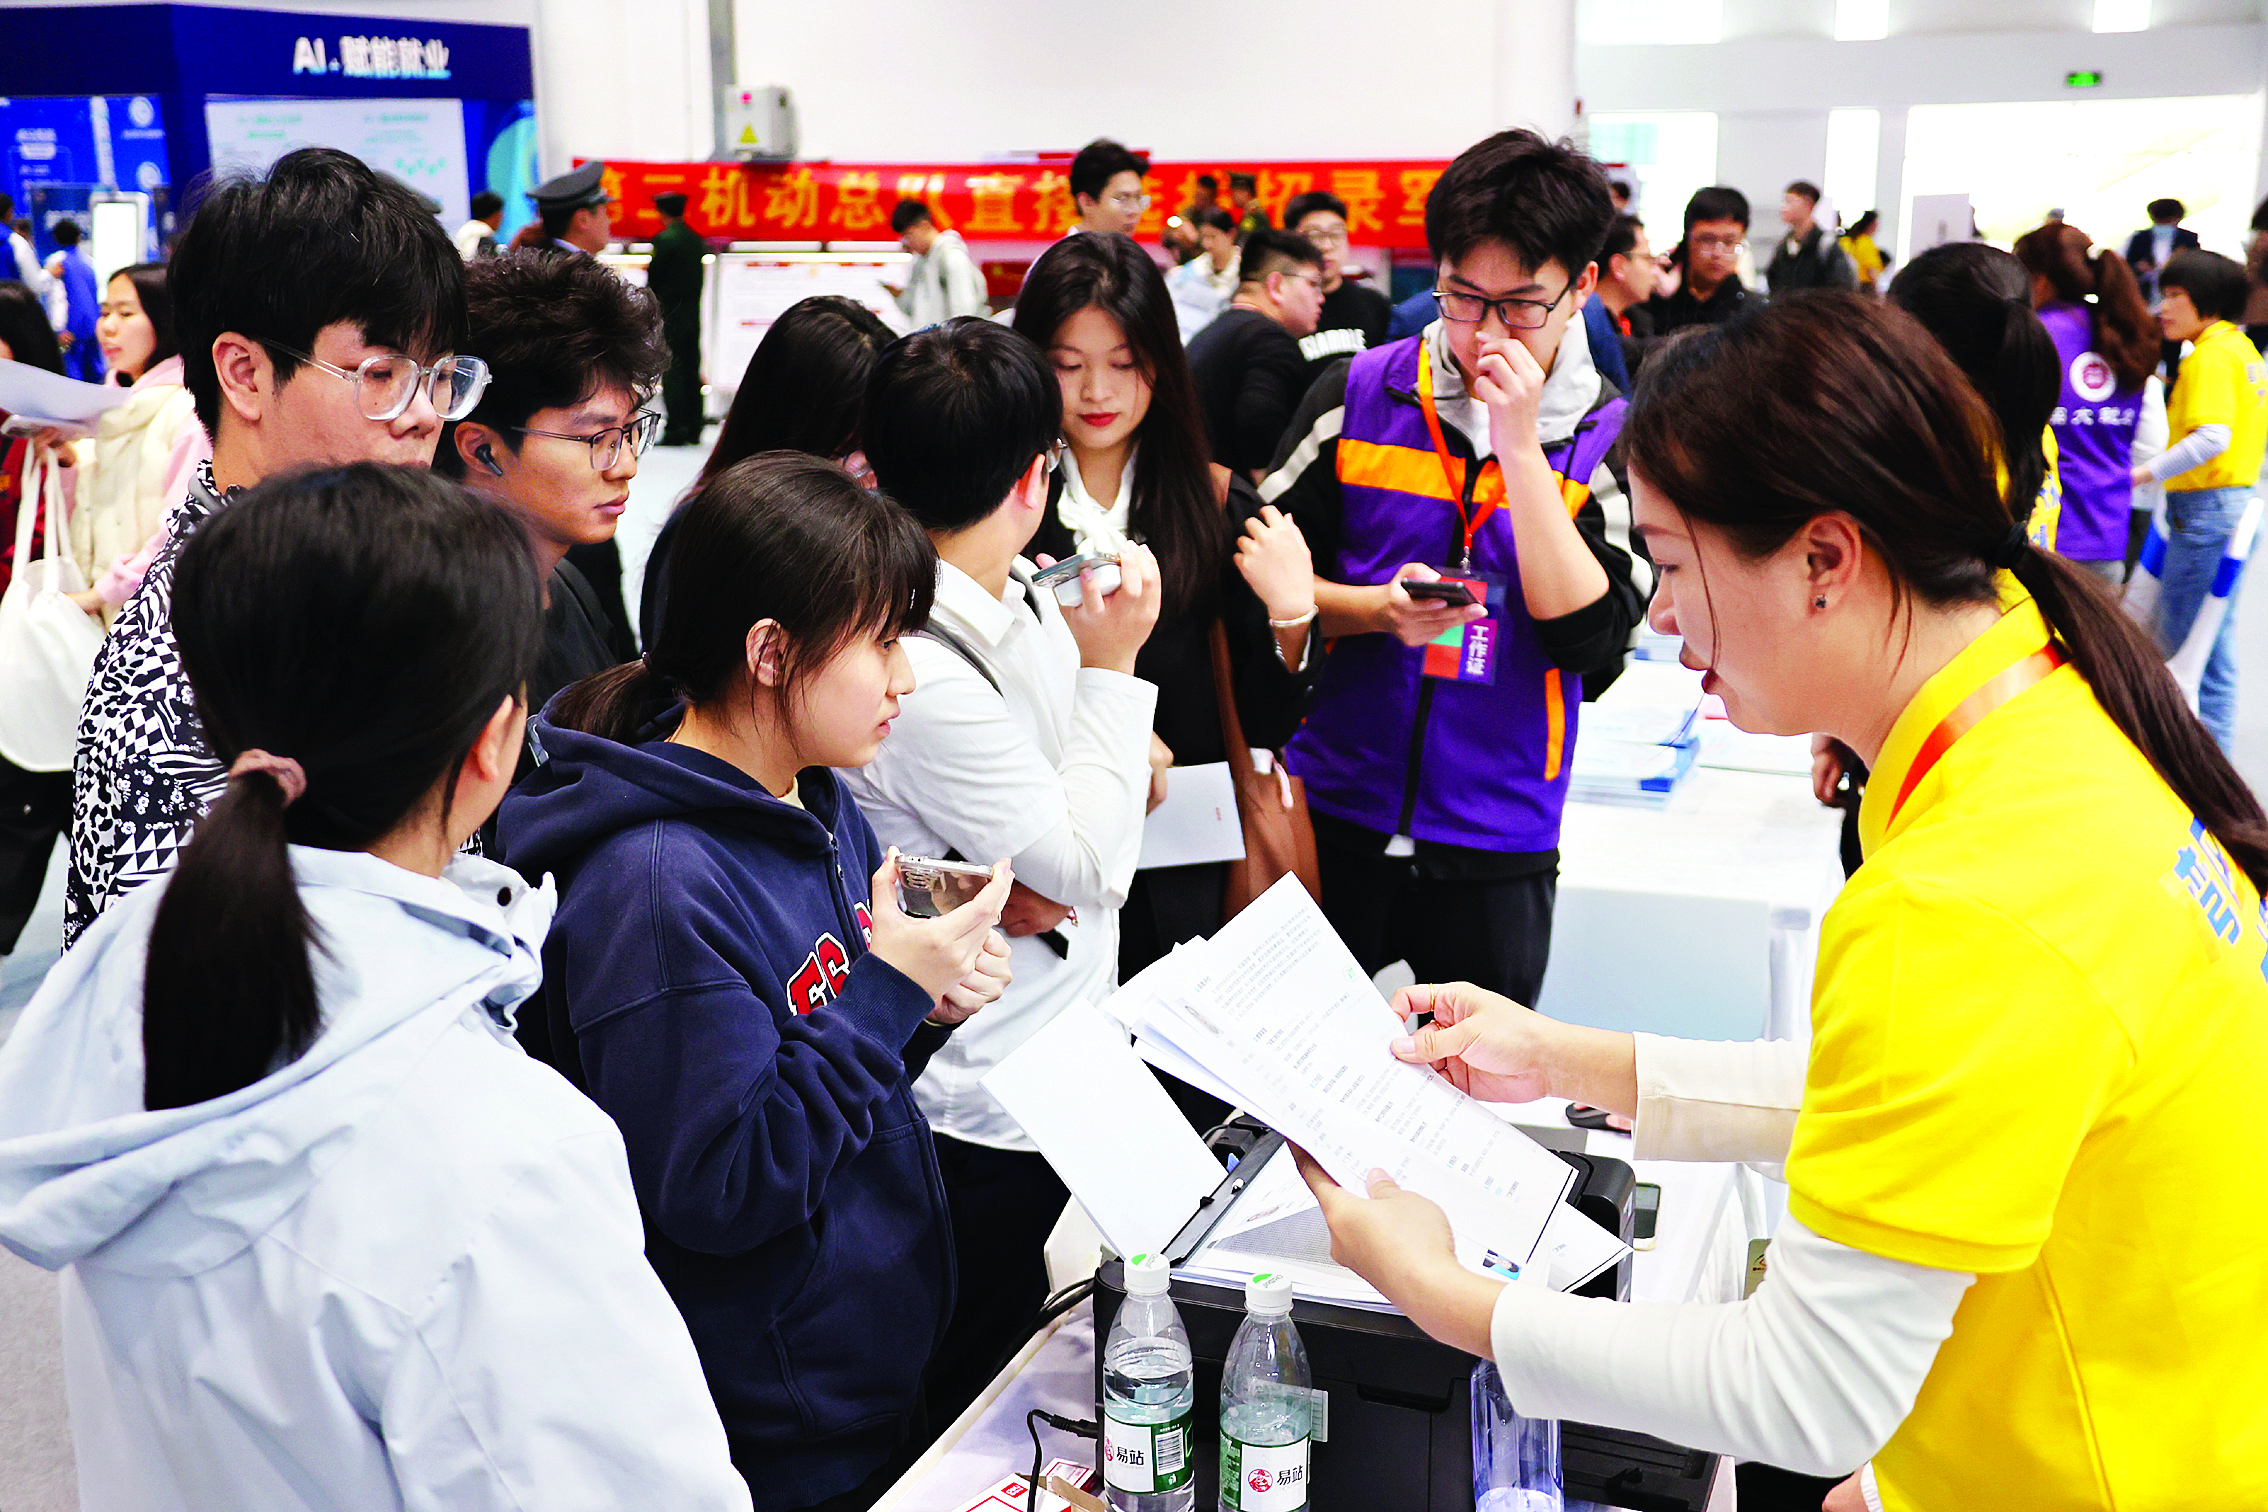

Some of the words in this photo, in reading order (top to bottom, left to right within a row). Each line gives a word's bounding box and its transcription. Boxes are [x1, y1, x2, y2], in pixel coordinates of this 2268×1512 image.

[1465, 624, 1490, 676] 工作证
[1116, 1446, 1145, 1466] 易站
[1277, 1465, 1304, 1486] 易站
